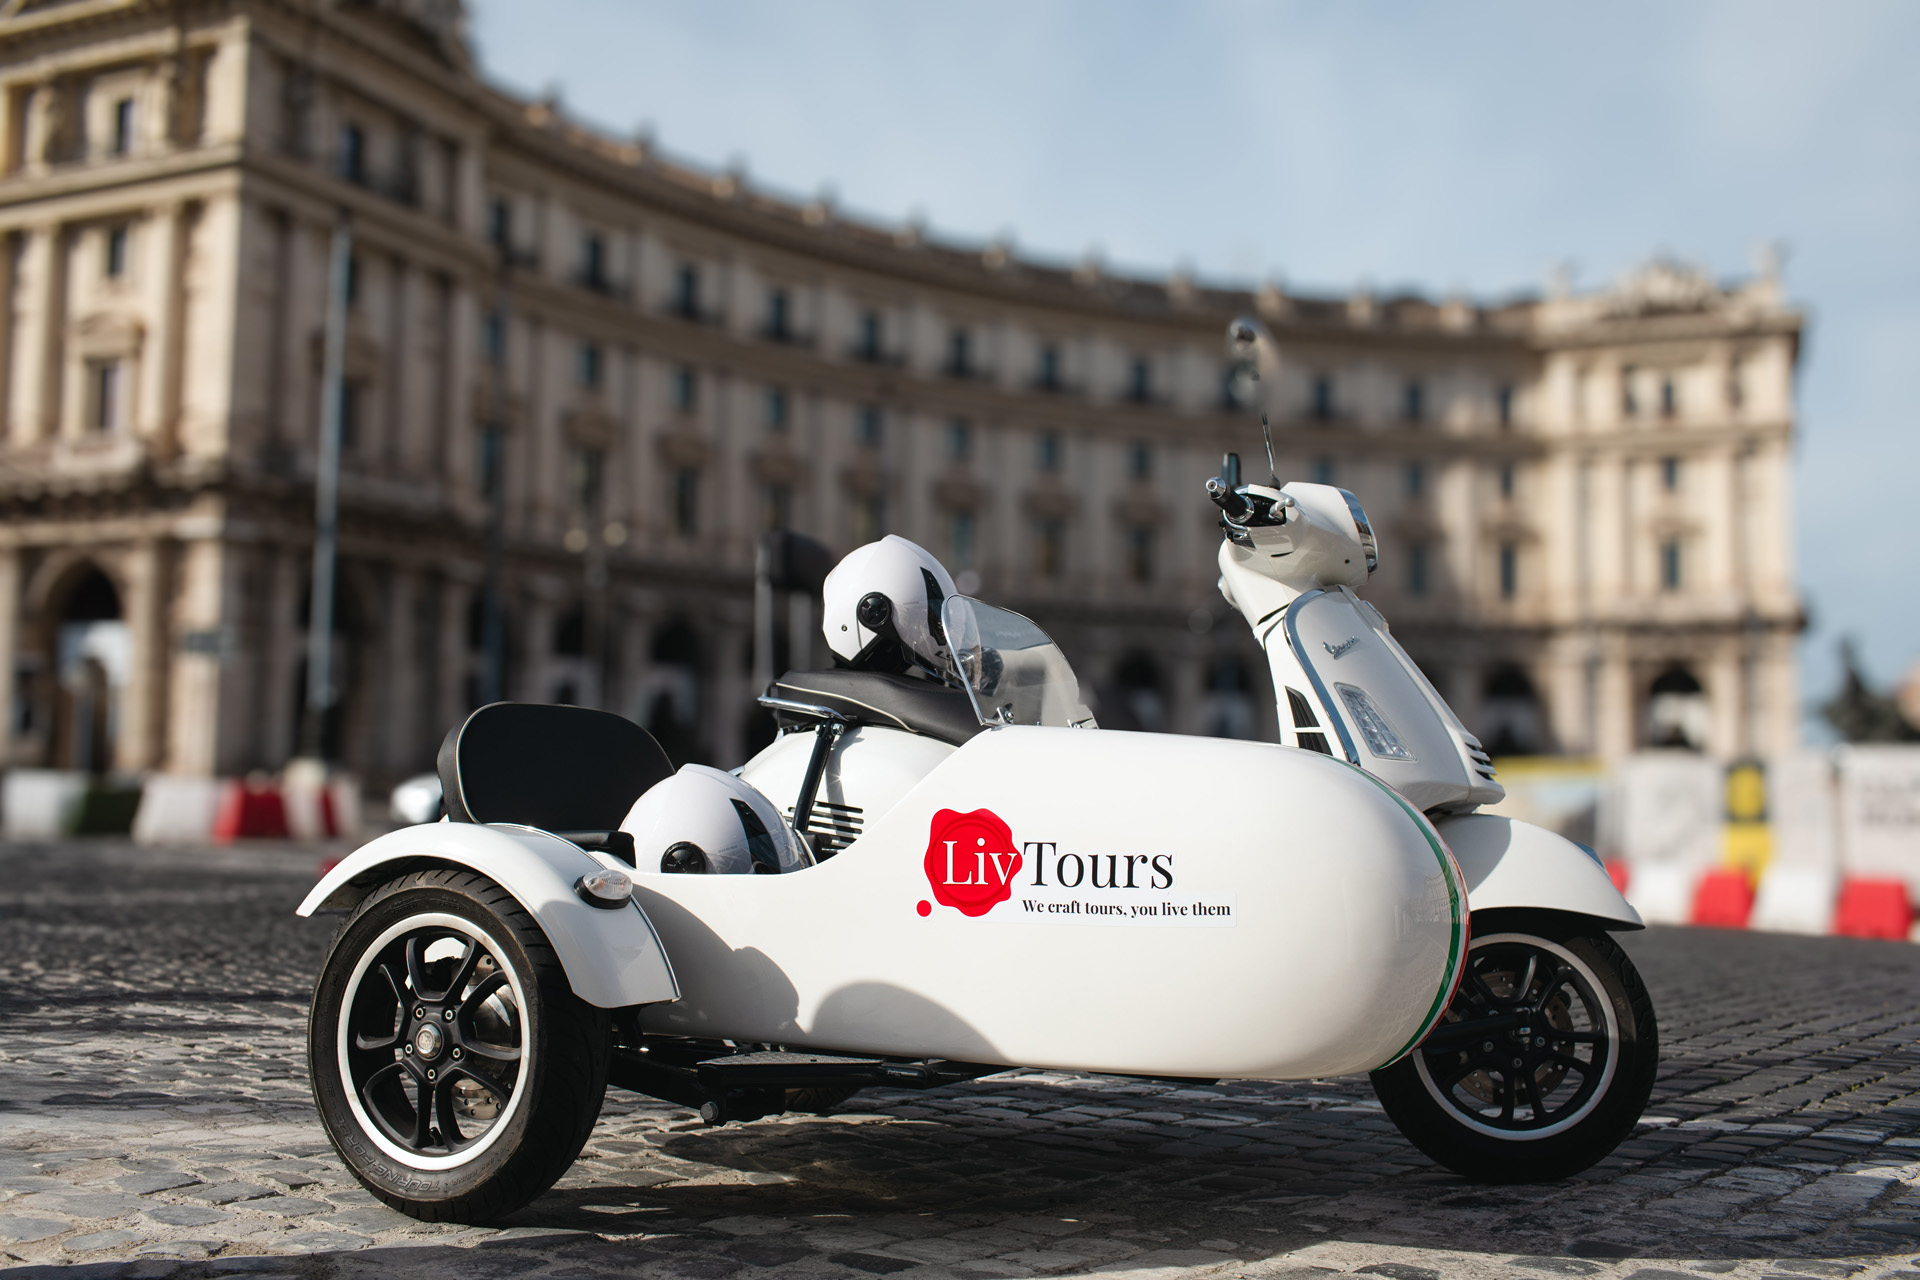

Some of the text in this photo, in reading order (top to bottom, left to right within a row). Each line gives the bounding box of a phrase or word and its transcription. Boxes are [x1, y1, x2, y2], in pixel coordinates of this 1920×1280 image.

[1022, 899, 1231, 919] We craft tours, you live them
